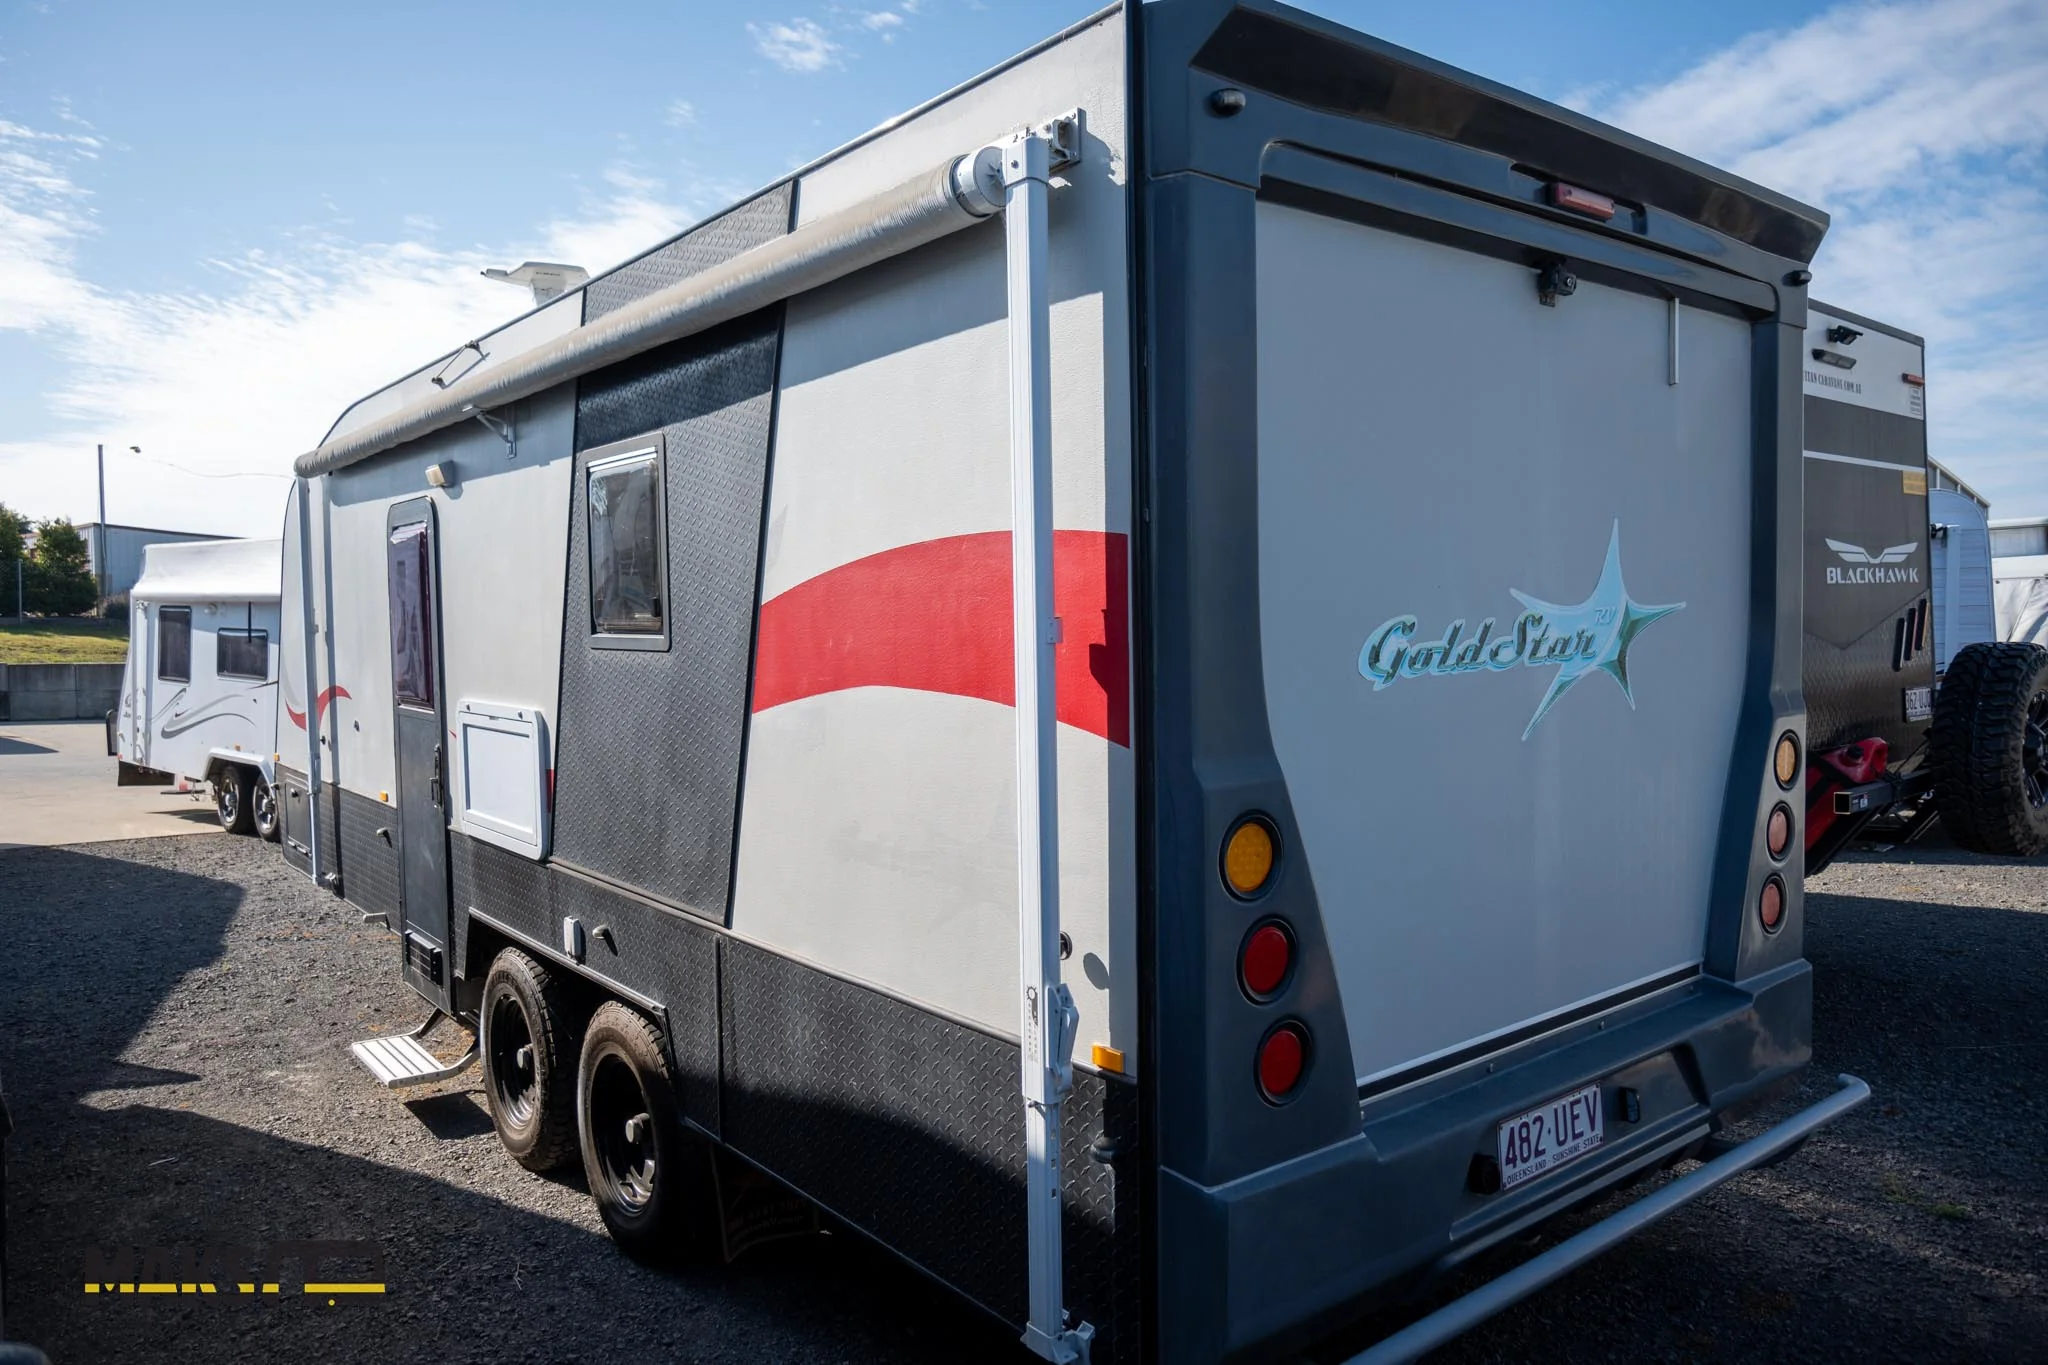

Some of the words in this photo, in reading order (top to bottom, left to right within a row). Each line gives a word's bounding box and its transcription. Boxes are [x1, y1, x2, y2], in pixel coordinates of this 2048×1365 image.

[1826, 566, 1919, 585] BLACKHAWK
[1359, 613, 1598, 690] GoldStar
[1506, 1160, 1546, 1185] QUEENSLAND
[1552, 1145, 1580, 1163] SUNSHINE
[1583, 1135, 1599, 1149] STATE
